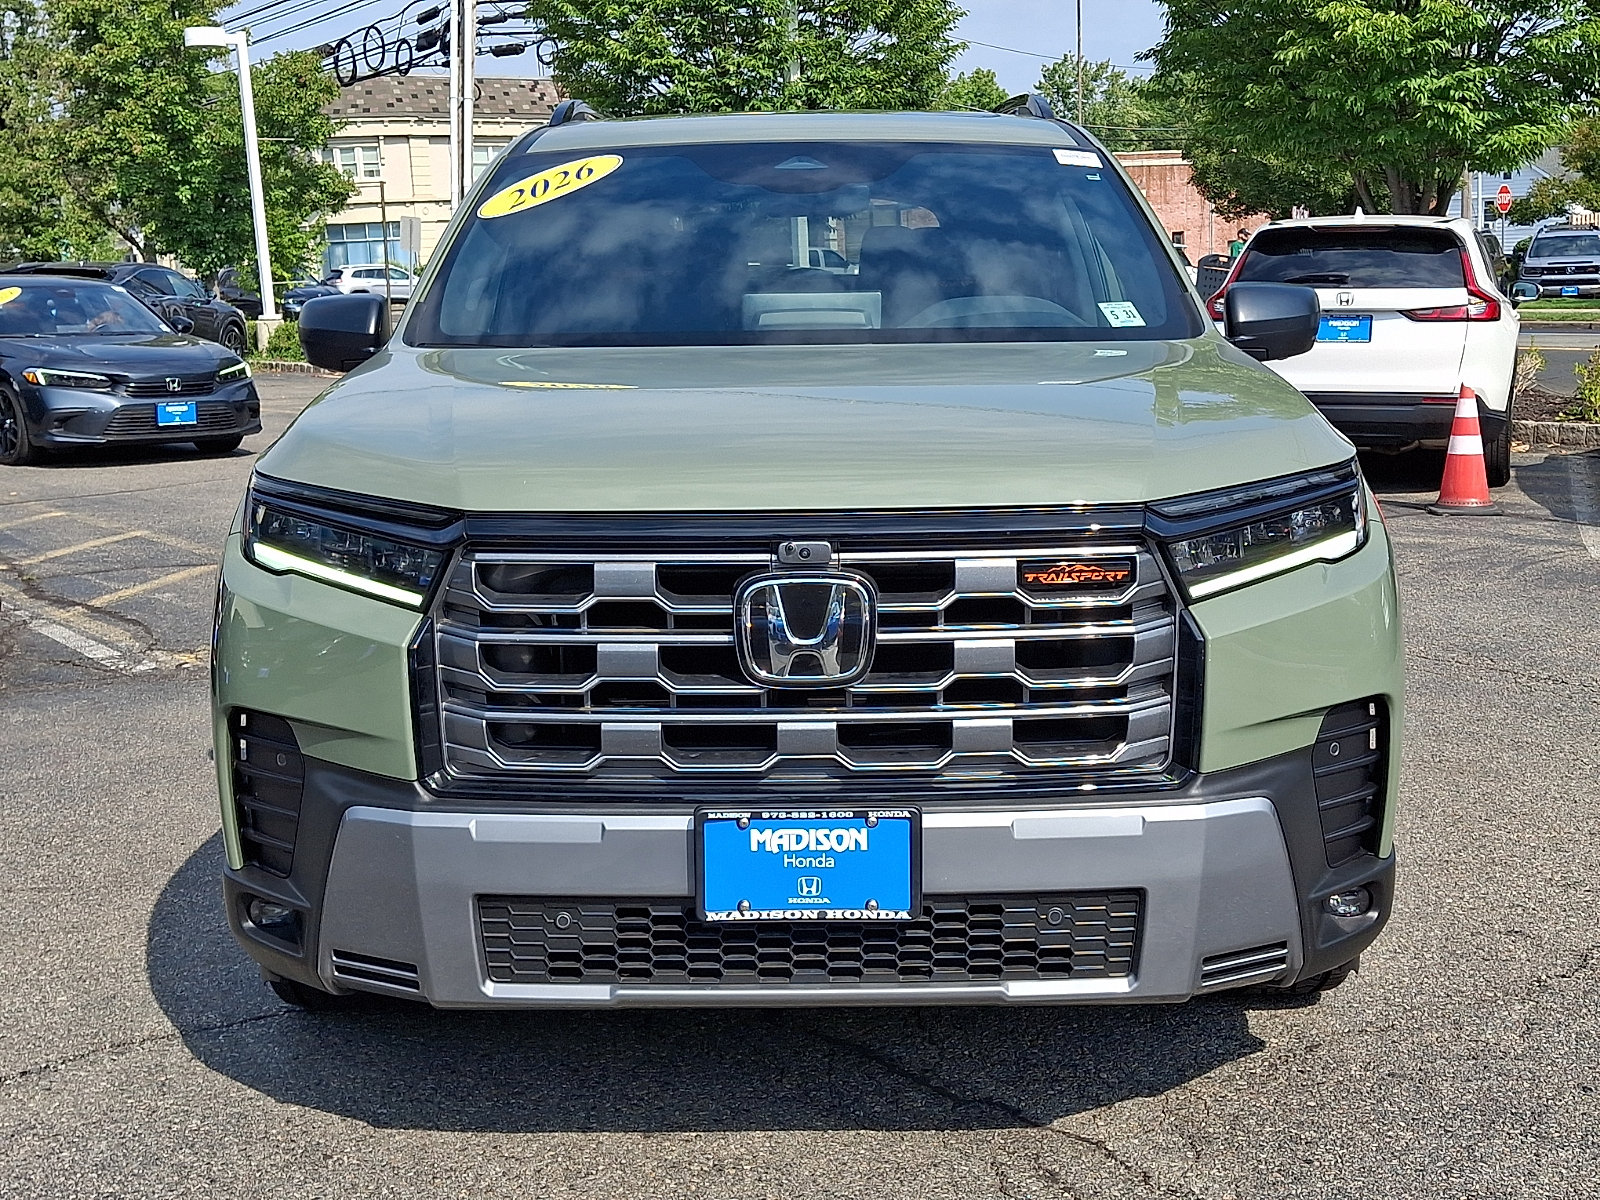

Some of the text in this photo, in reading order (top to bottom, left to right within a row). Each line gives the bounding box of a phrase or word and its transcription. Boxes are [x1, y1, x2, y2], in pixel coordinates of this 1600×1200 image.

[508, 160, 594, 210] 2026
[1497, 193, 1511, 204] STOP
[1110, 309, 1137, 320] 5 31
[1024, 571, 1128, 584] TRAILSPORT
[867, 810, 912, 818] HONDA
[750, 827, 868, 854] MADISON
[783, 853, 835, 868] Honda
[705, 909, 912, 922] MADISON HONDA
